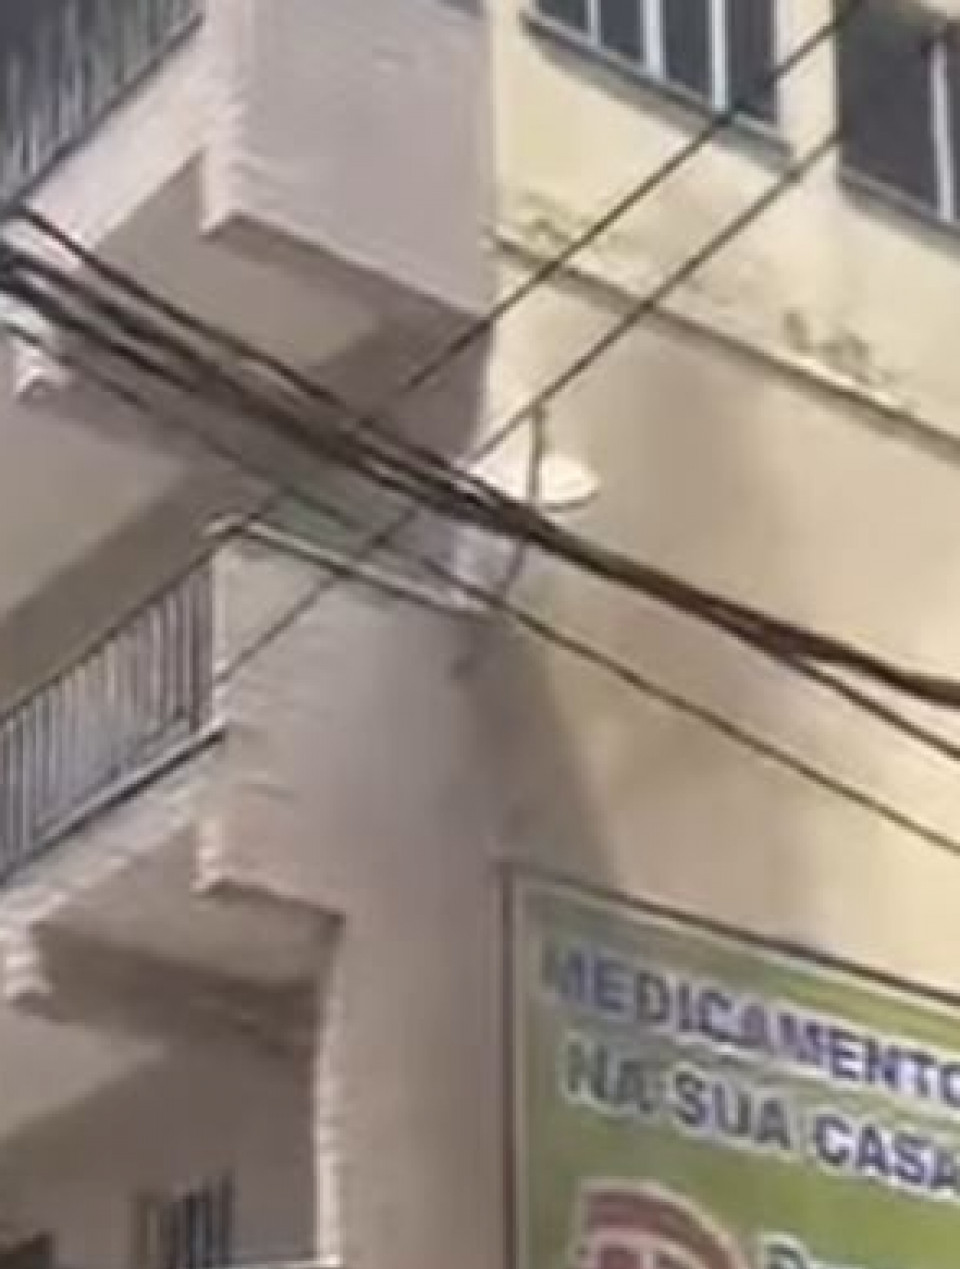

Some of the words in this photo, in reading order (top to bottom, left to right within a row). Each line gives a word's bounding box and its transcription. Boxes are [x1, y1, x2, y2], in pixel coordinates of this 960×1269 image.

[566, 1038, 651, 1114] NA
[674, 1070, 791, 1151] SUA
[813, 1115, 960, 1190] CASA
